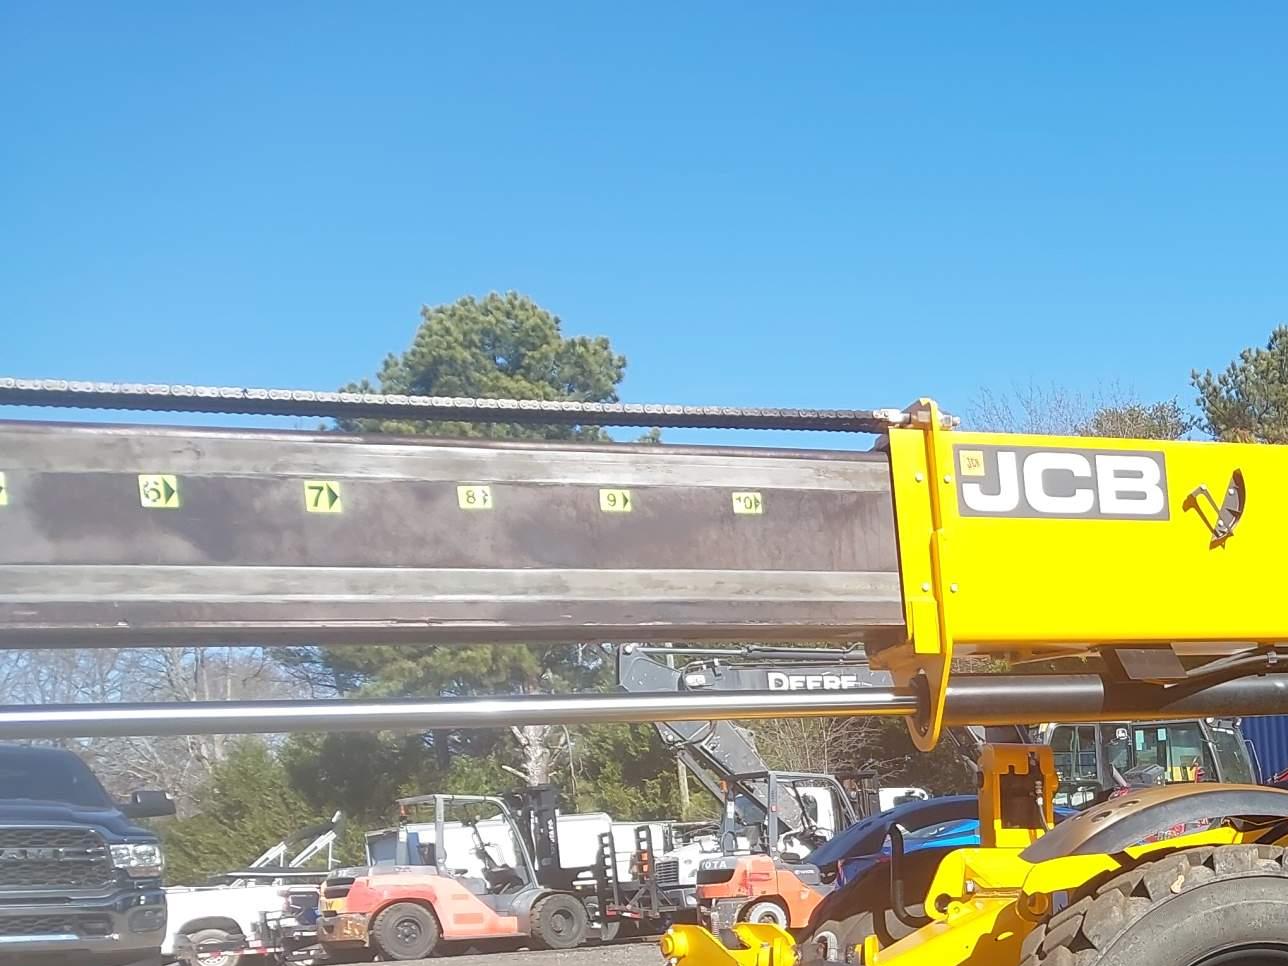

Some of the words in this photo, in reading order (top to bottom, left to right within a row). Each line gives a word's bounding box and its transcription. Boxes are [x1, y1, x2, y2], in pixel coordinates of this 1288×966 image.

[143, 480, 161, 503] 6
[962, 450, 1164, 515] JCB
[307, 486, 325, 508] 7
[465, 489, 477, 505] 8
[606, 493, 618, 507] 9
[767, 672, 858, 691] DEERE
